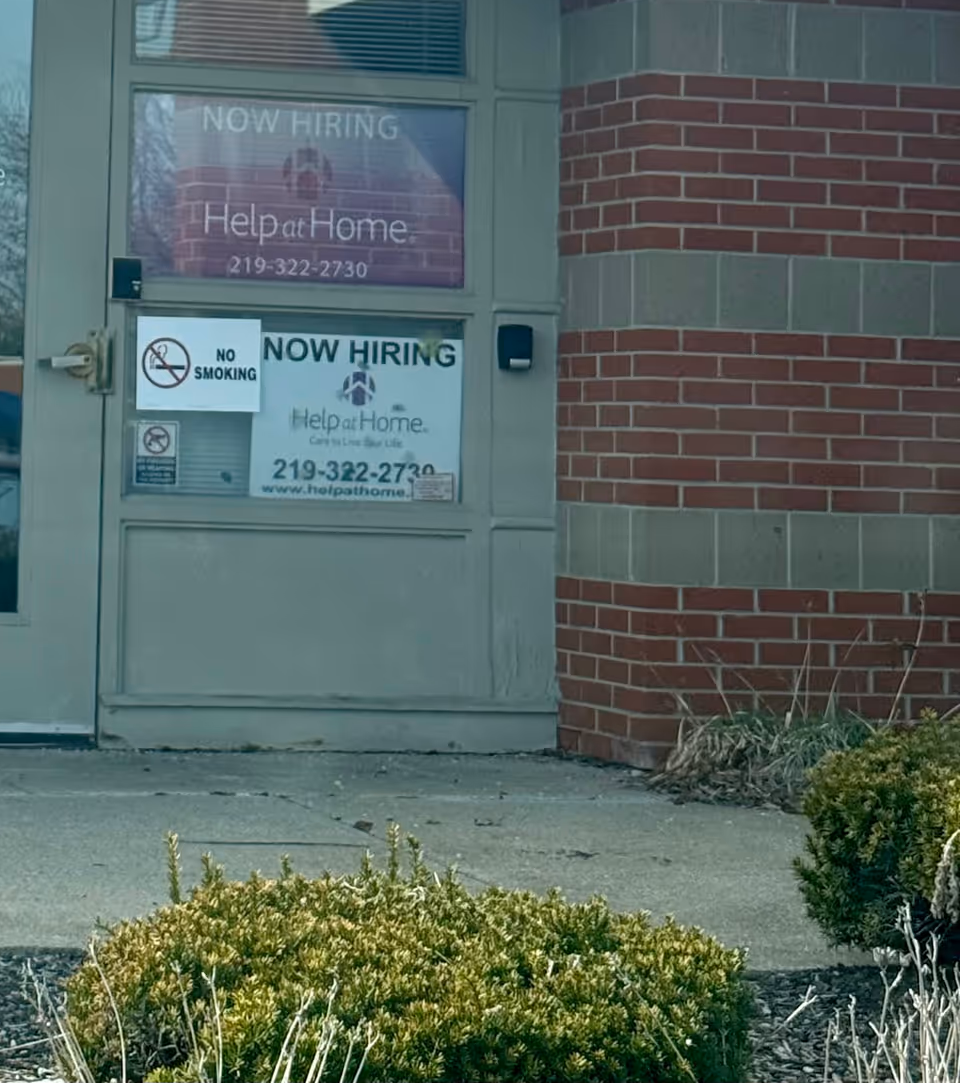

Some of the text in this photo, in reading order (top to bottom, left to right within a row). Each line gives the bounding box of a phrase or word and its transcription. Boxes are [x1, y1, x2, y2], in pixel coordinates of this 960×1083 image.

[203, 105, 399, 141] NOW HIRING
[204, 203, 279, 246] Help
[282, 217, 305, 239] at
[229, 256, 368, 279] 219-322-2730
[216, 347, 236, 363] NO
[262, 335, 457, 369] NOW HIRING
[194, 365, 258, 382] SMOKING
[291, 406, 341, 435] Help
[342, 415, 358, 431] at
